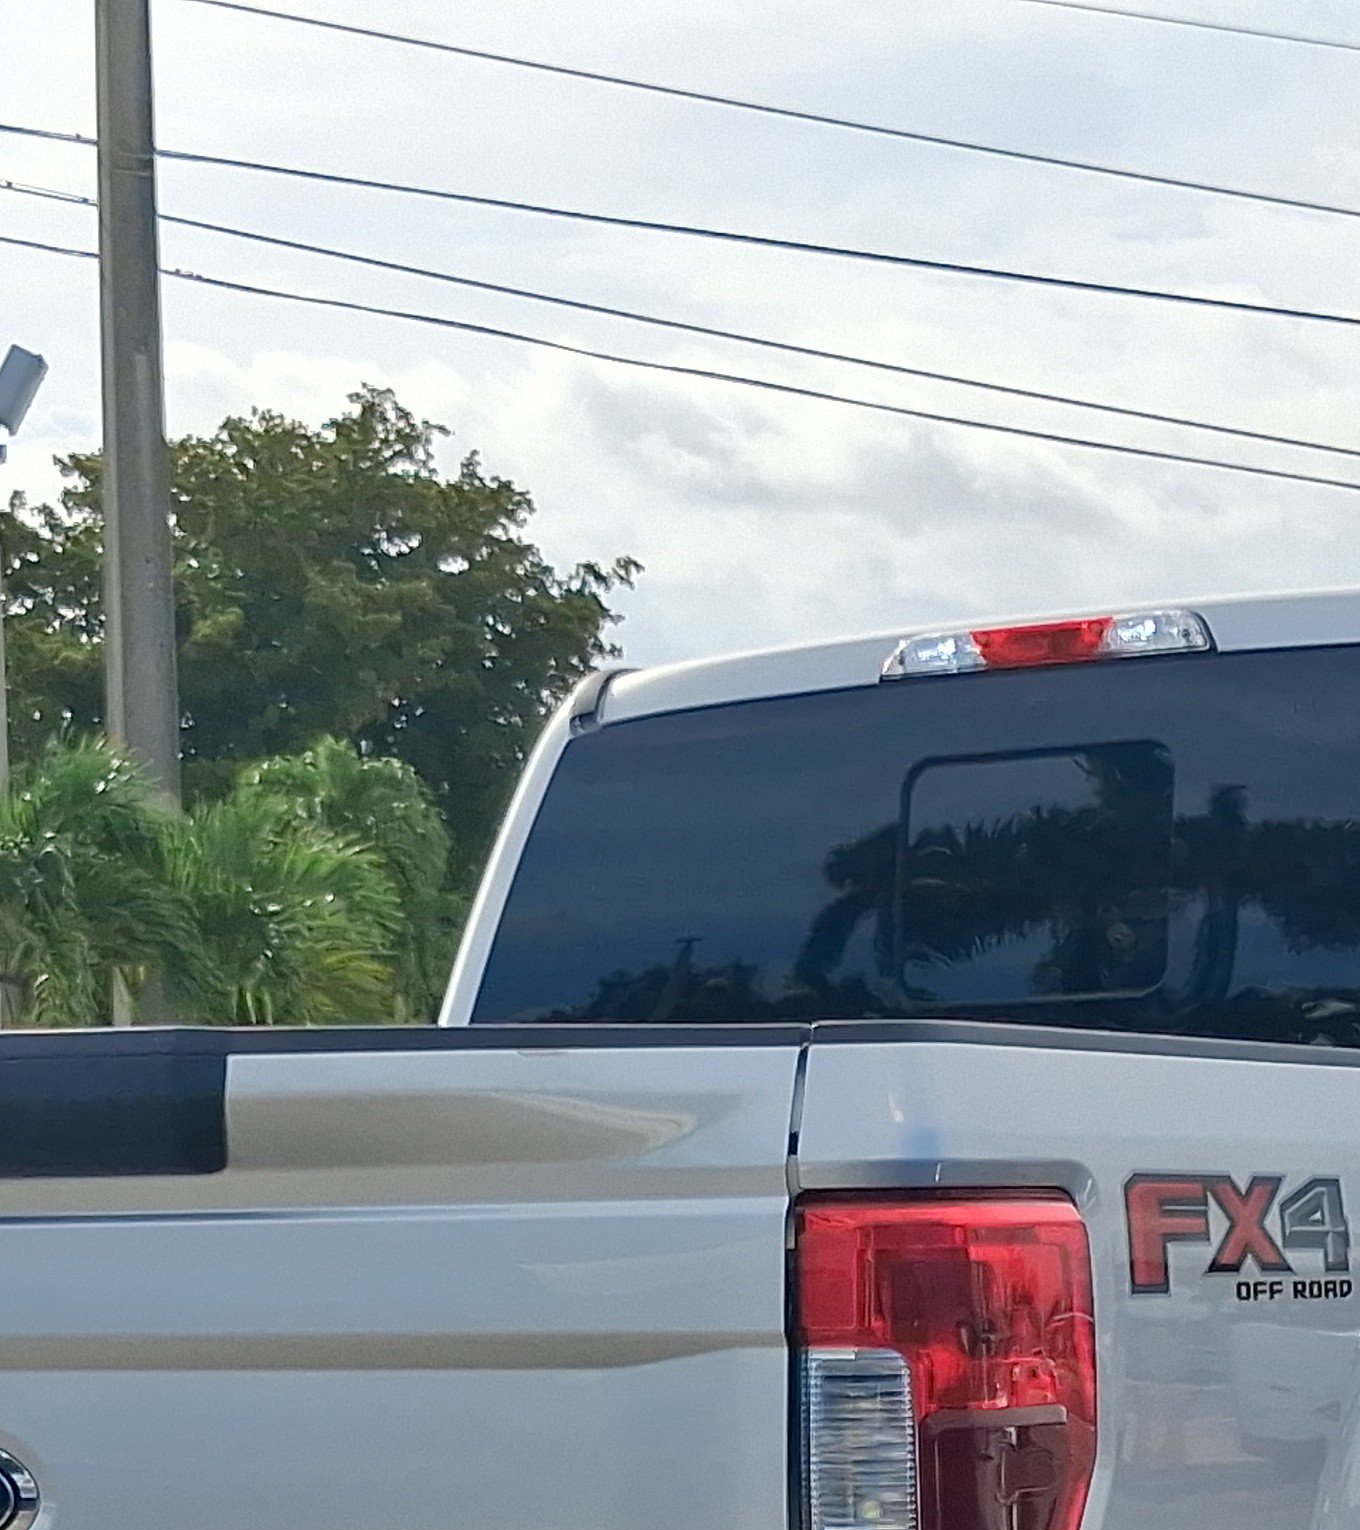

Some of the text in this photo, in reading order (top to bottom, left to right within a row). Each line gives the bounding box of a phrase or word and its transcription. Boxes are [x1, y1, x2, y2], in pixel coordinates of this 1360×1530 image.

[1124, 1172, 1350, 1295] FX4
[1235, 1278, 1352, 1301] OFF ROAD
